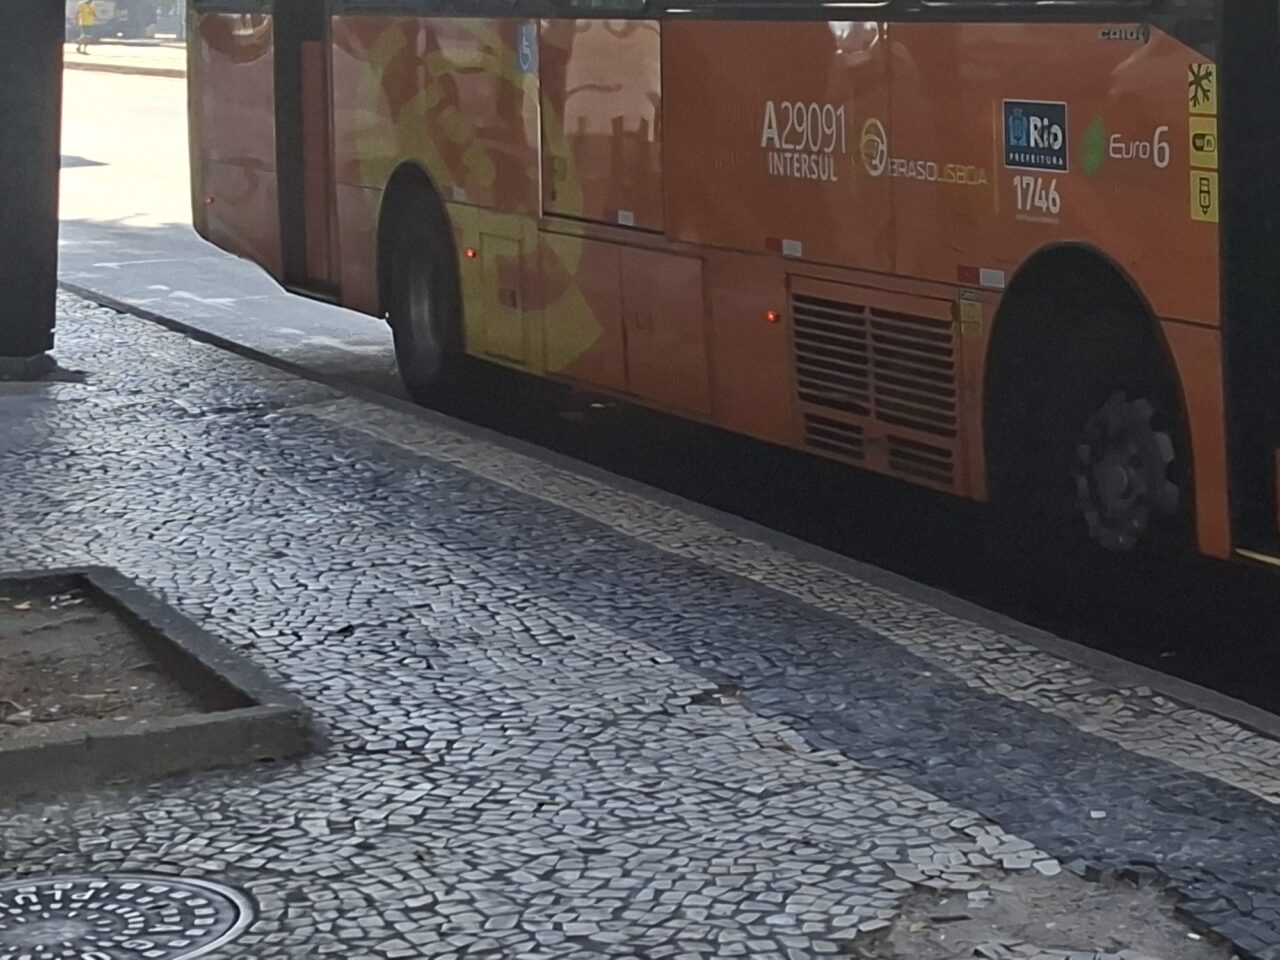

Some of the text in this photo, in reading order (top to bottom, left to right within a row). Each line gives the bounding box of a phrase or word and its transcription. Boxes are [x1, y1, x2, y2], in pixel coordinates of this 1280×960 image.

[760, 100, 846, 154] A29091
[1029, 116, 1063, 150] Rio
[769, 152, 838, 181] INTERSUL
[1009, 152, 1063, 165] PREFEITURA
[1013, 175, 1060, 214] 1746
